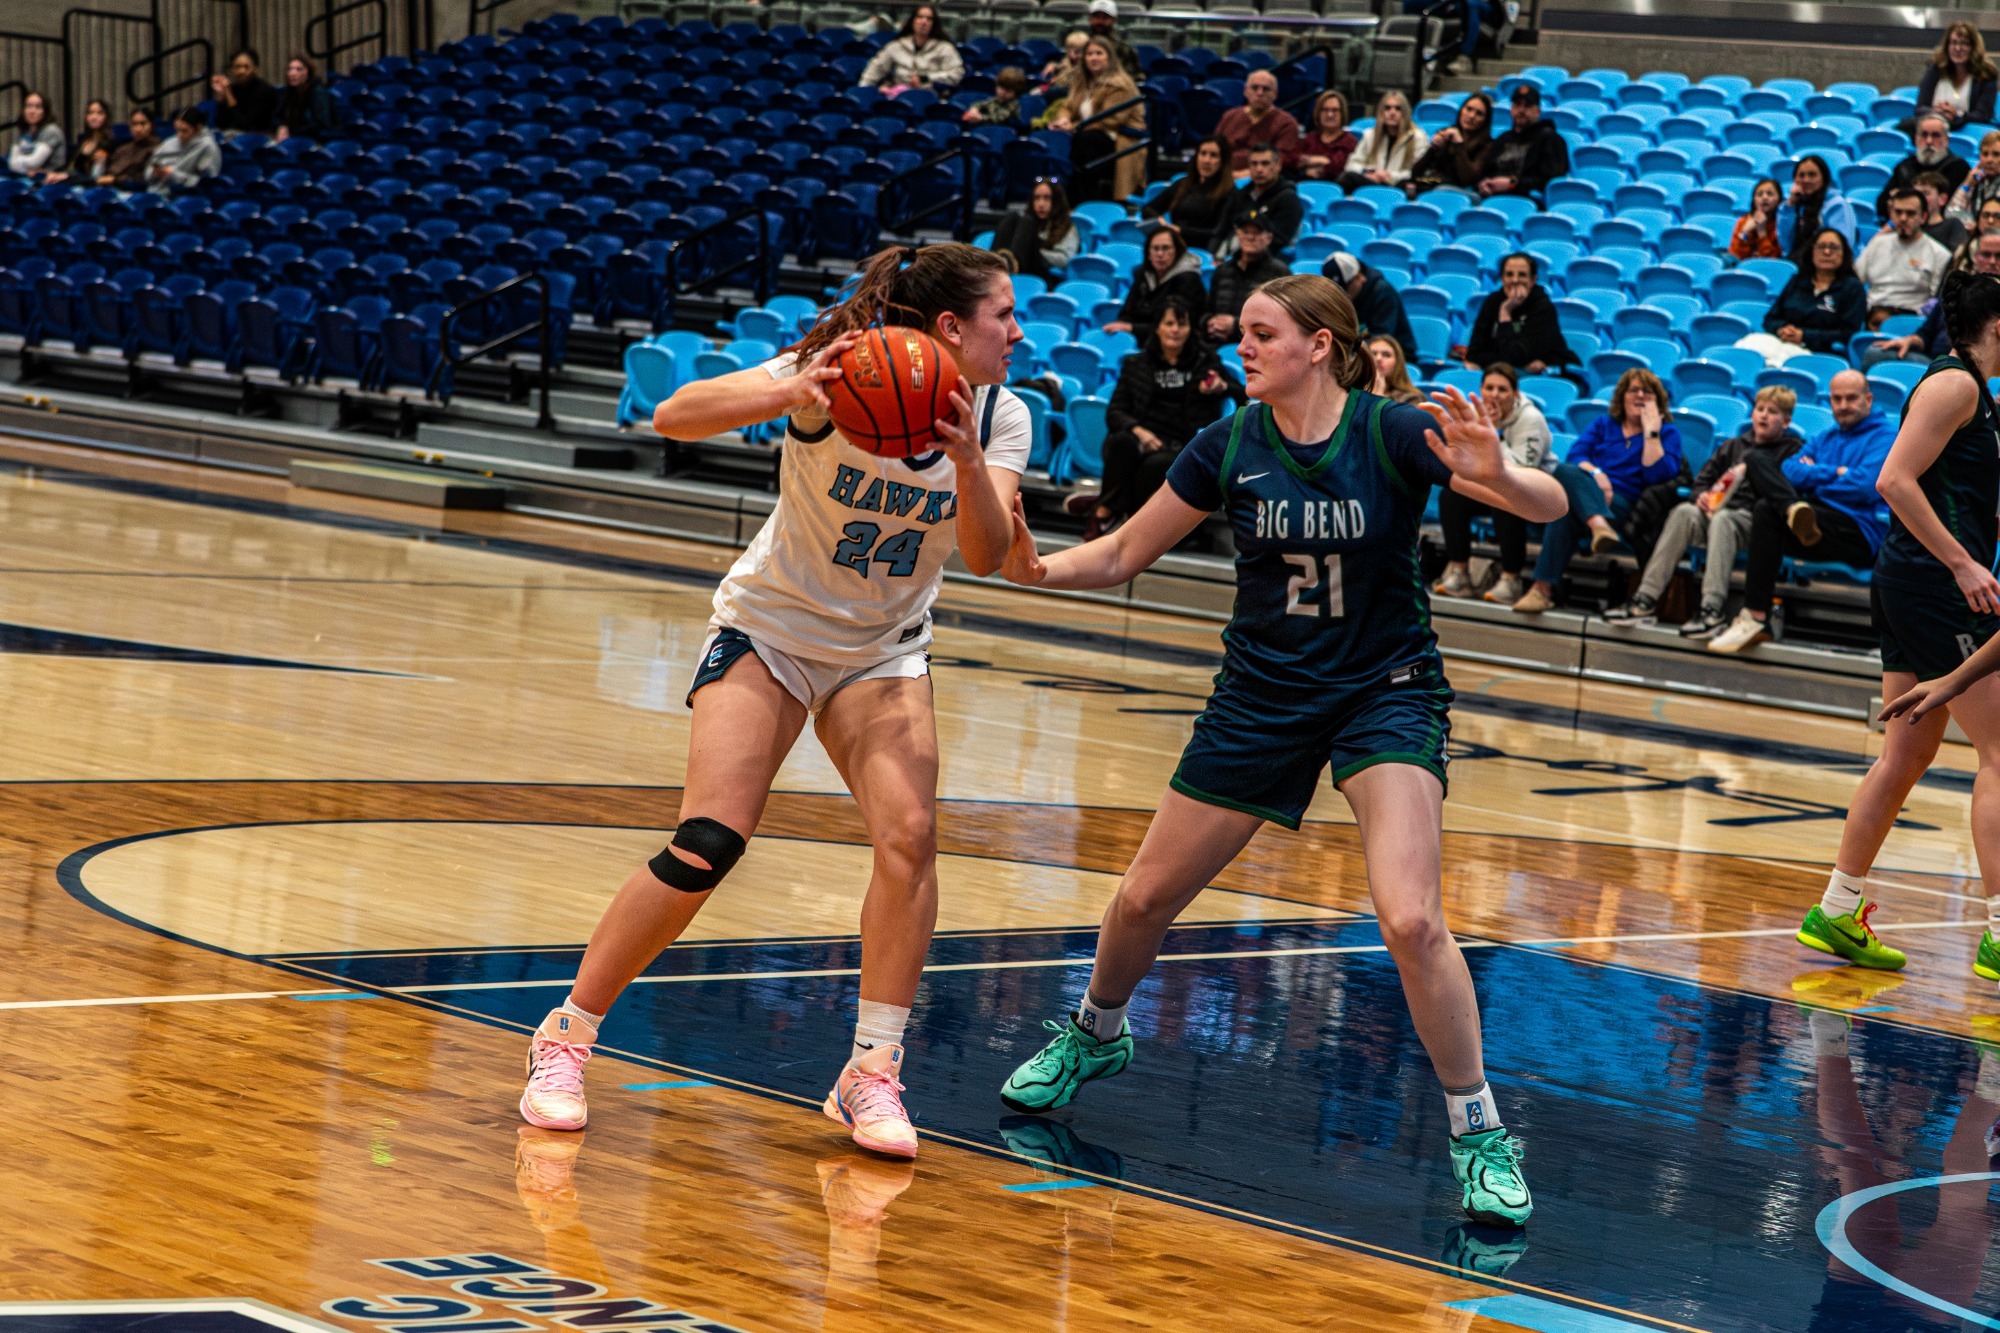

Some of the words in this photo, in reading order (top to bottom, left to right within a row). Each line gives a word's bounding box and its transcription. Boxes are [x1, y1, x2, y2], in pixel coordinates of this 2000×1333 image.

[1256, 500, 1289, 539] BIG
[1303, 499, 1365, 539] BEND
[832, 521, 928, 579] 24
[1281, 554, 1344, 617] 21
